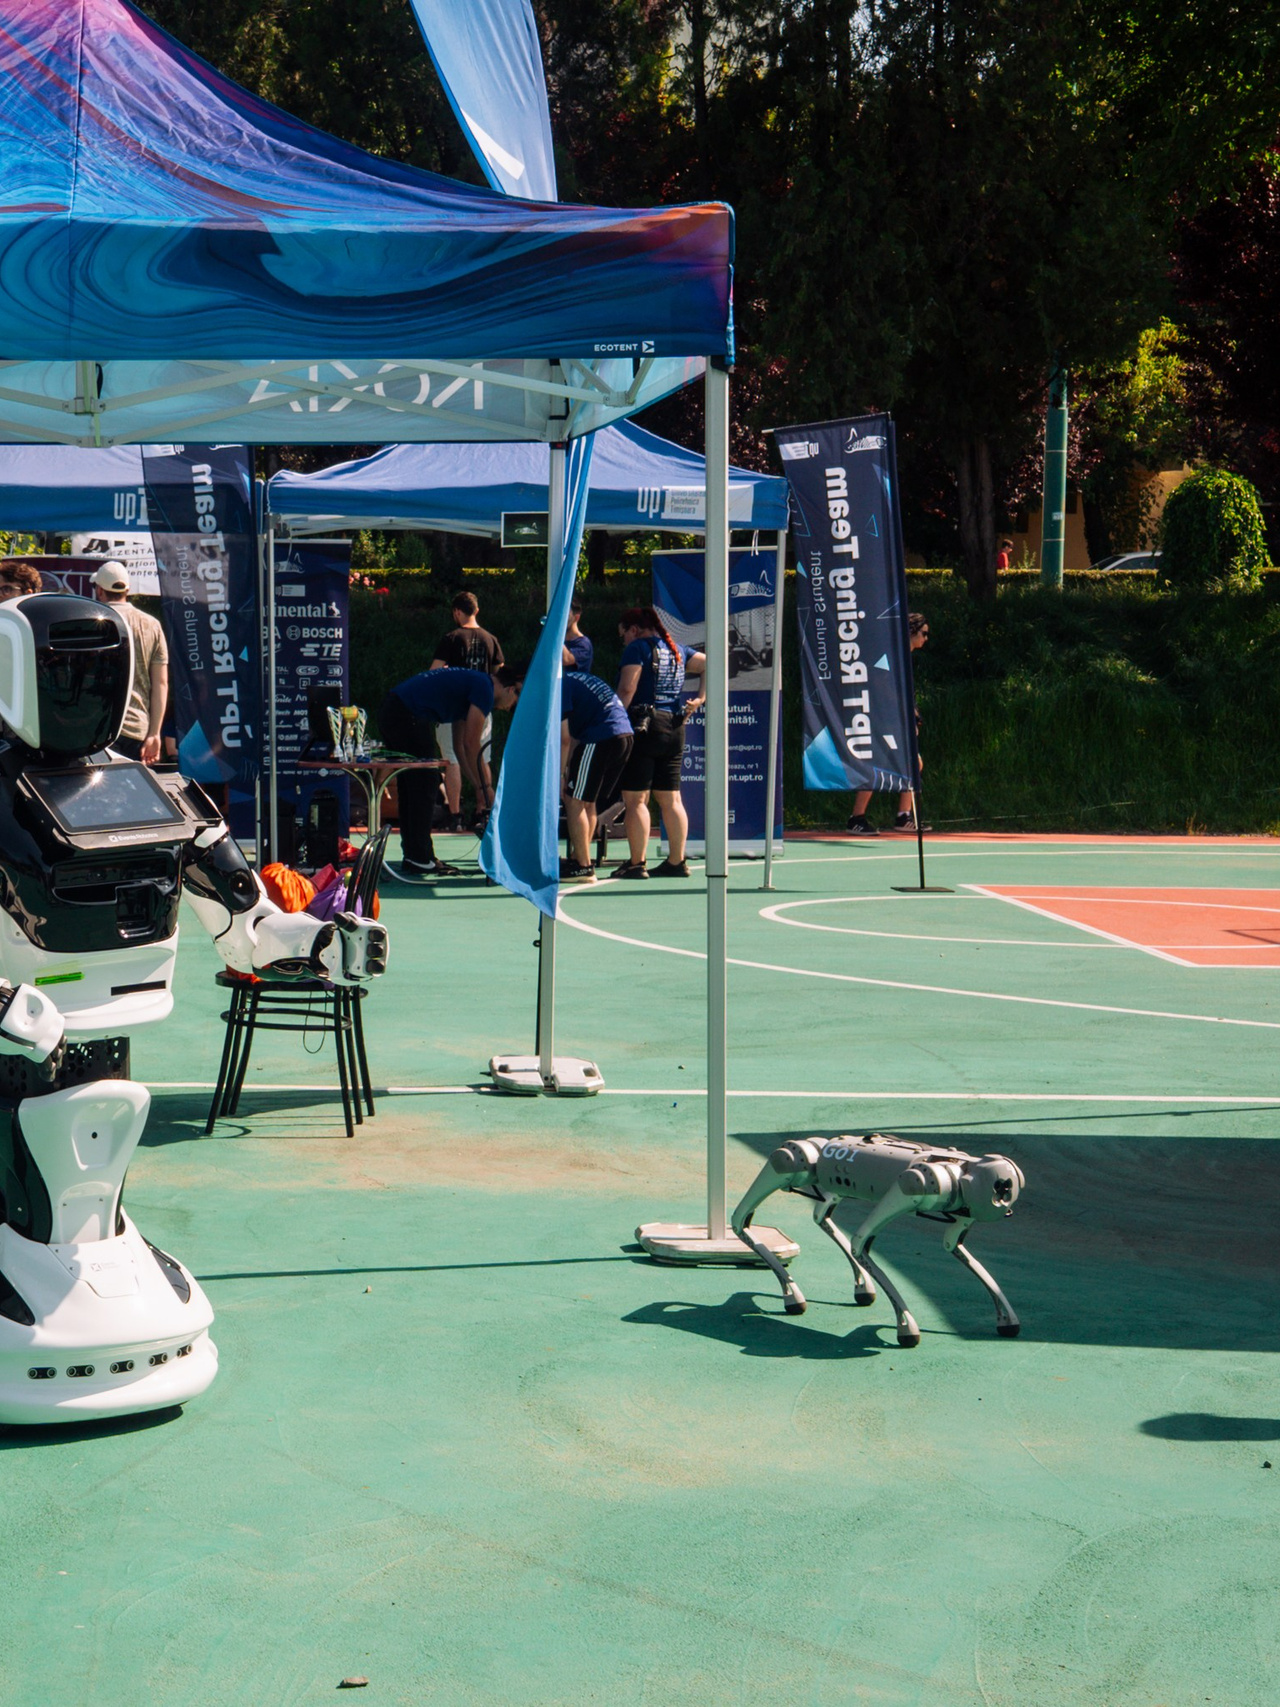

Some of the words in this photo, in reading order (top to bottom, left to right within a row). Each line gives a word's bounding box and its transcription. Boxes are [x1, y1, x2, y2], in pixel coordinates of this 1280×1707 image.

[594, 344, 638, 352] ECOTENT
[302, 627, 343, 639] BOSCH
[322, 643, 342, 656] TE
